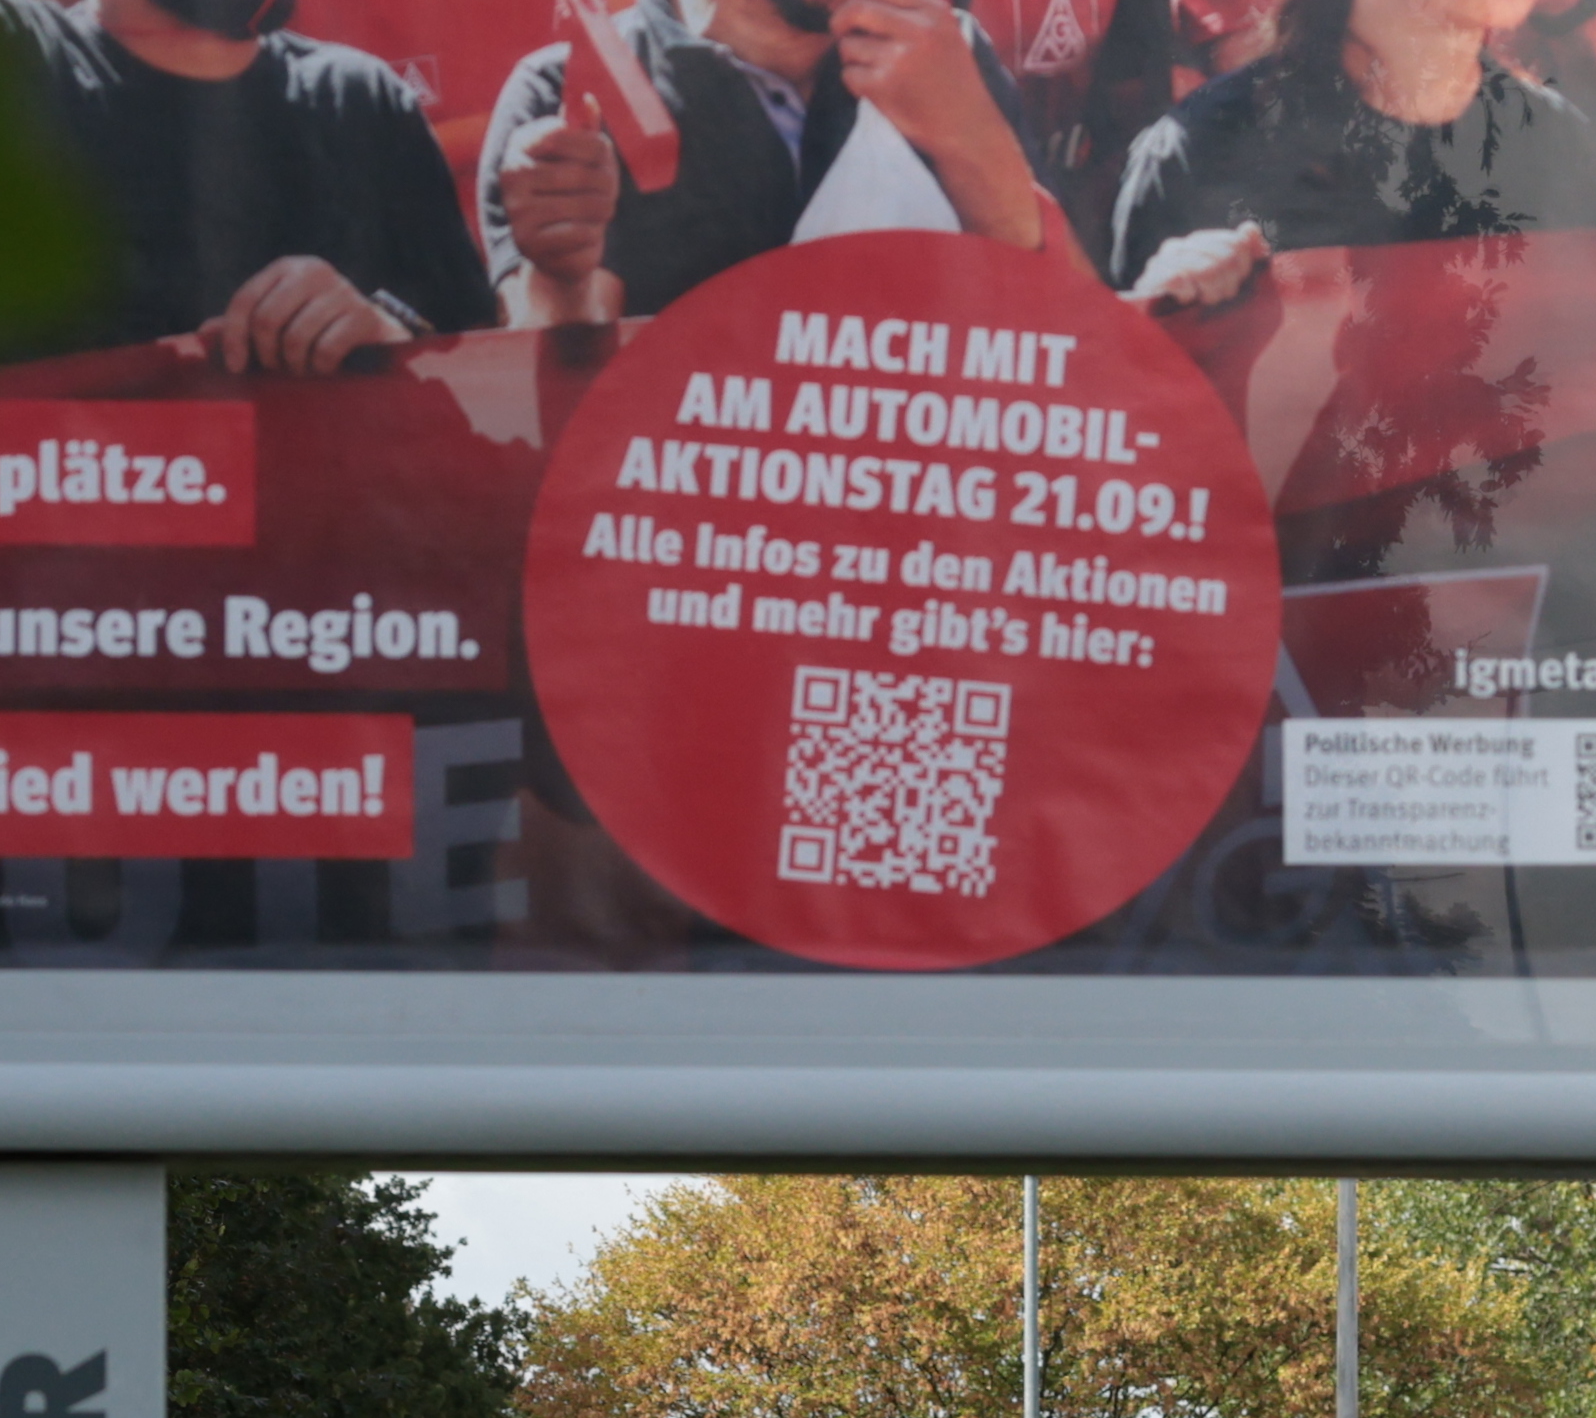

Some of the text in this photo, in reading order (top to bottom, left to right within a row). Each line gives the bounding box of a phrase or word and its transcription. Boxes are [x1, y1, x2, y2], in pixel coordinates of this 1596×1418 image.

[775, 311, 1076, 387] MACH MIT
[677, 373, 1160, 464] AM AUTOMOBIL-
[616, 437, 1208, 542] AKTIONSTAG 21.09.!
[583, 512, 1226, 615] Alle Infos zu den Aktionen
[225, 594, 479, 673] Region.
[647, 584, 1153, 668] und mehr gibt's hier:
[1305, 733, 1535, 759] Politische Werbung
[1305, 765, 1548, 789] Dieser QR-Code führt
[113, 753, 386, 817] werden!
[1305, 798, 1497, 824] zur Transparenz-
[1305, 831, 1509, 858] bekanntmachung
